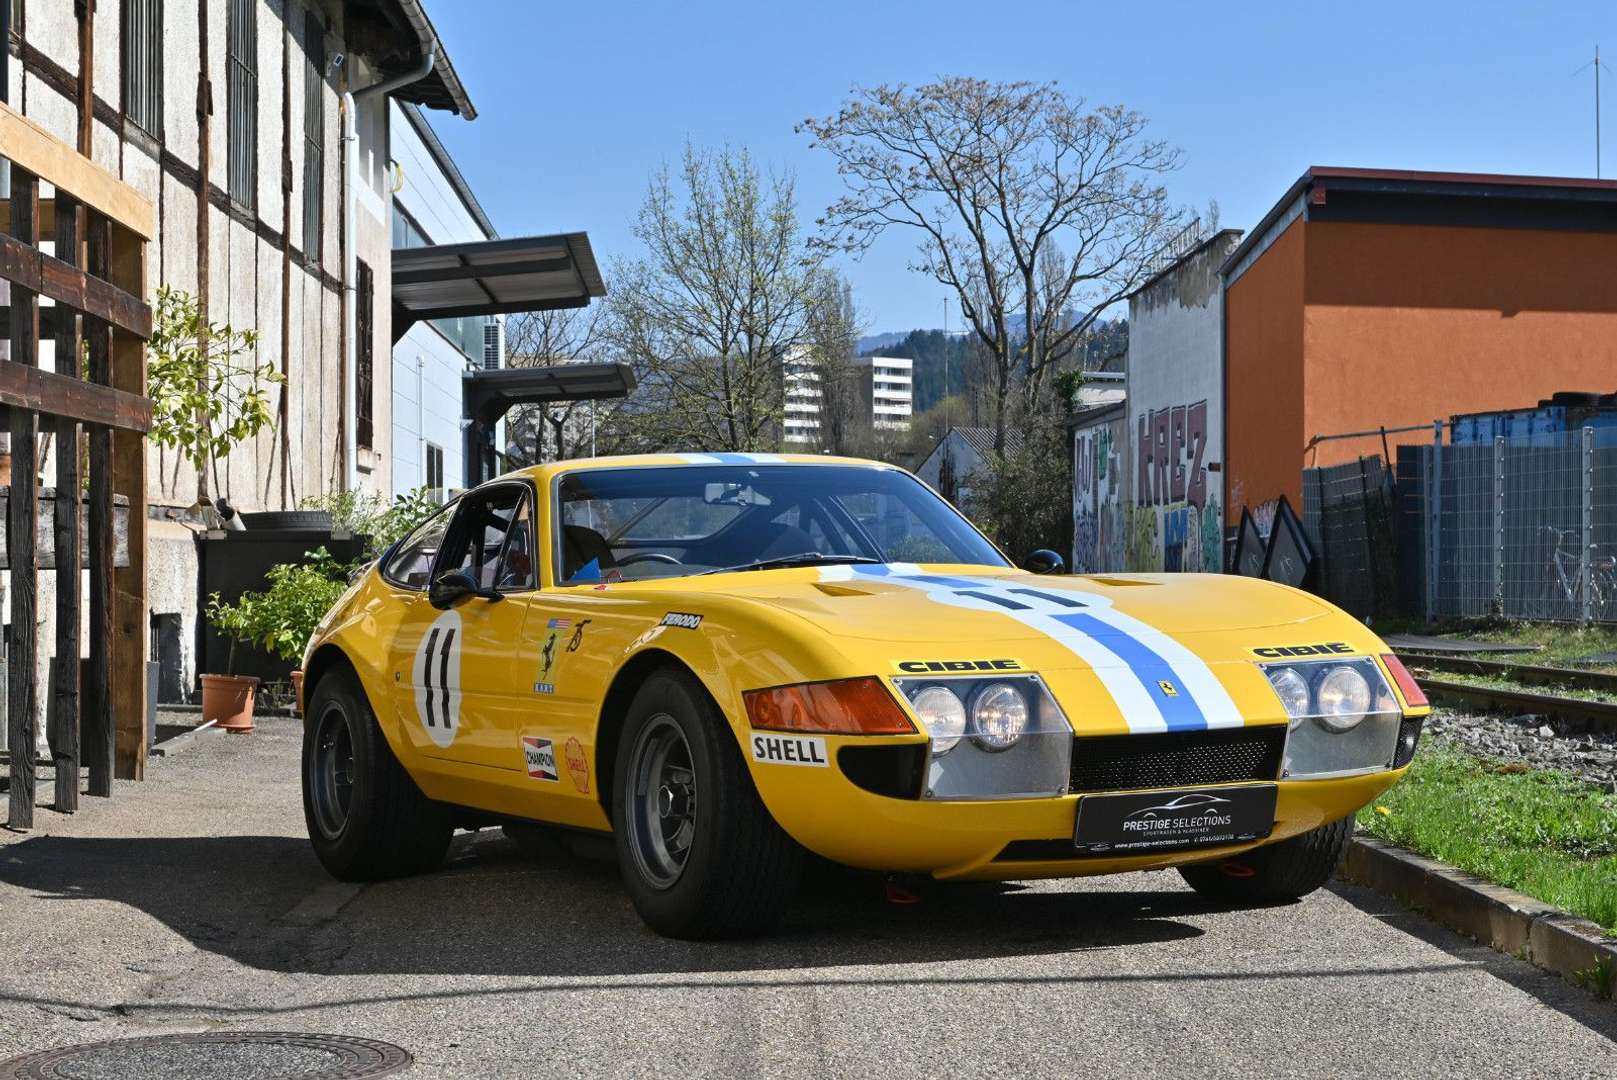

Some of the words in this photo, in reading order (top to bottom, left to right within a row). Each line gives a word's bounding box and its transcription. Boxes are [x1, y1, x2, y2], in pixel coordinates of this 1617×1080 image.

[424, 628, 456, 728] 11
[754, 736, 825, 763] SHELL
[1123, 819, 1171, 831] PRESTIGE
[1173, 815, 1232, 828] SELECTIONS
